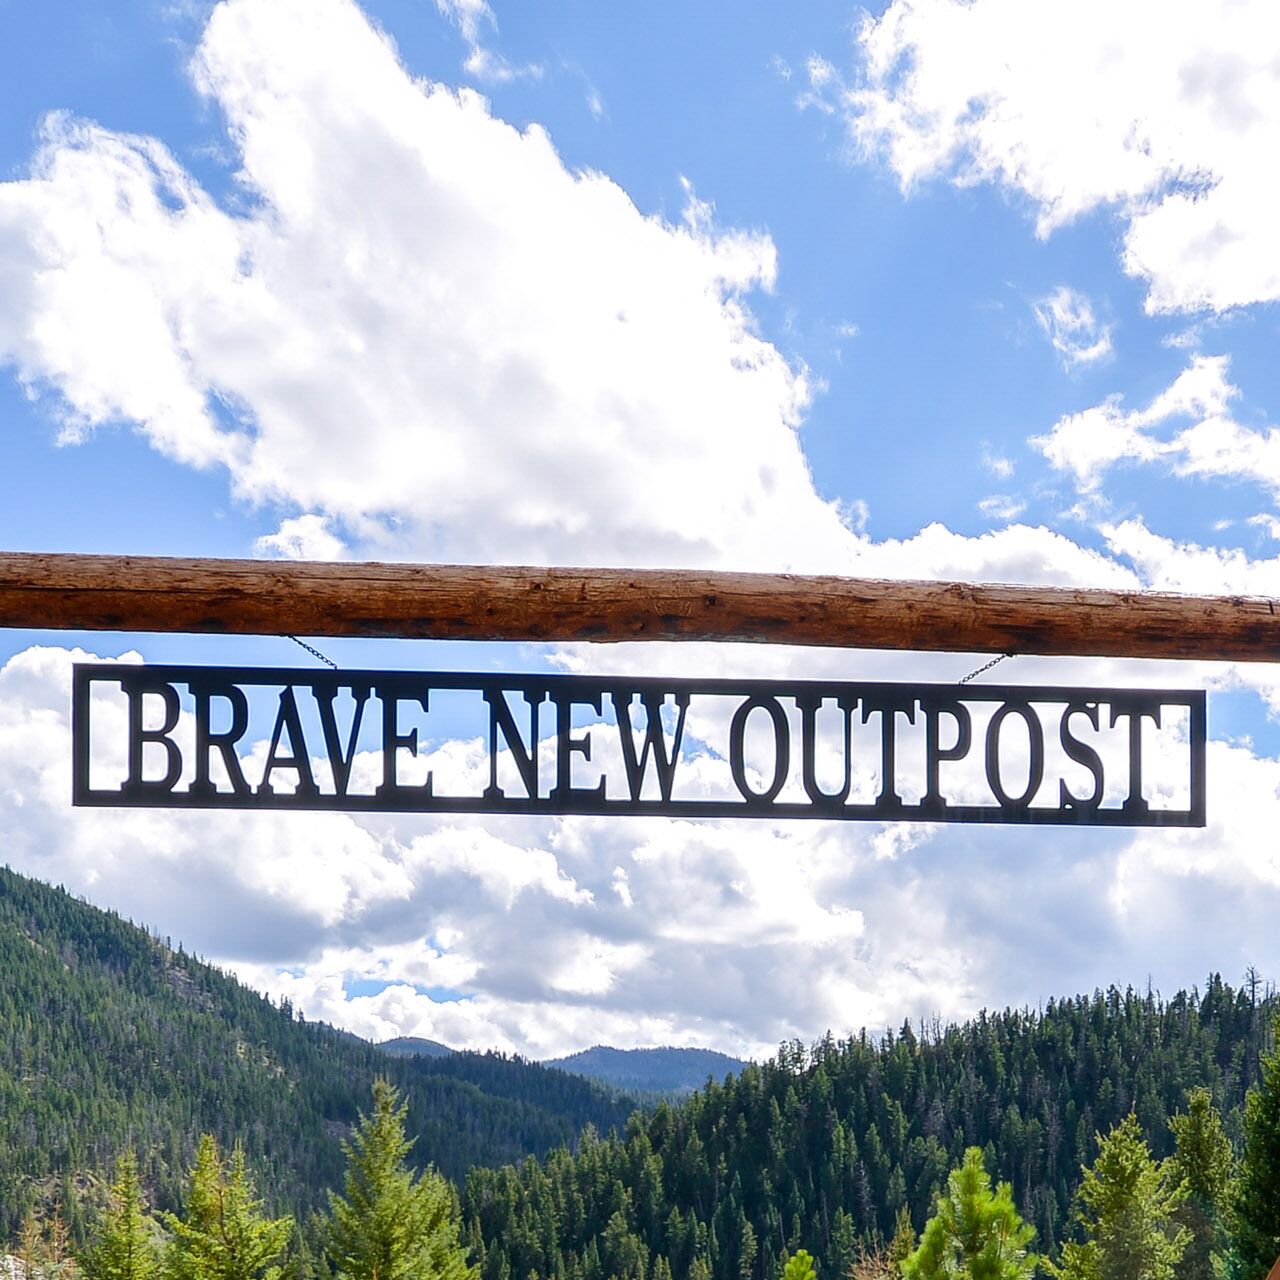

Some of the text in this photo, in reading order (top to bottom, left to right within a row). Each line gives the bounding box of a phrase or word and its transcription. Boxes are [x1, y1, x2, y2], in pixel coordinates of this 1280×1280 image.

[120, 680, 1162, 812] BRAVE NEW OUTPOST
